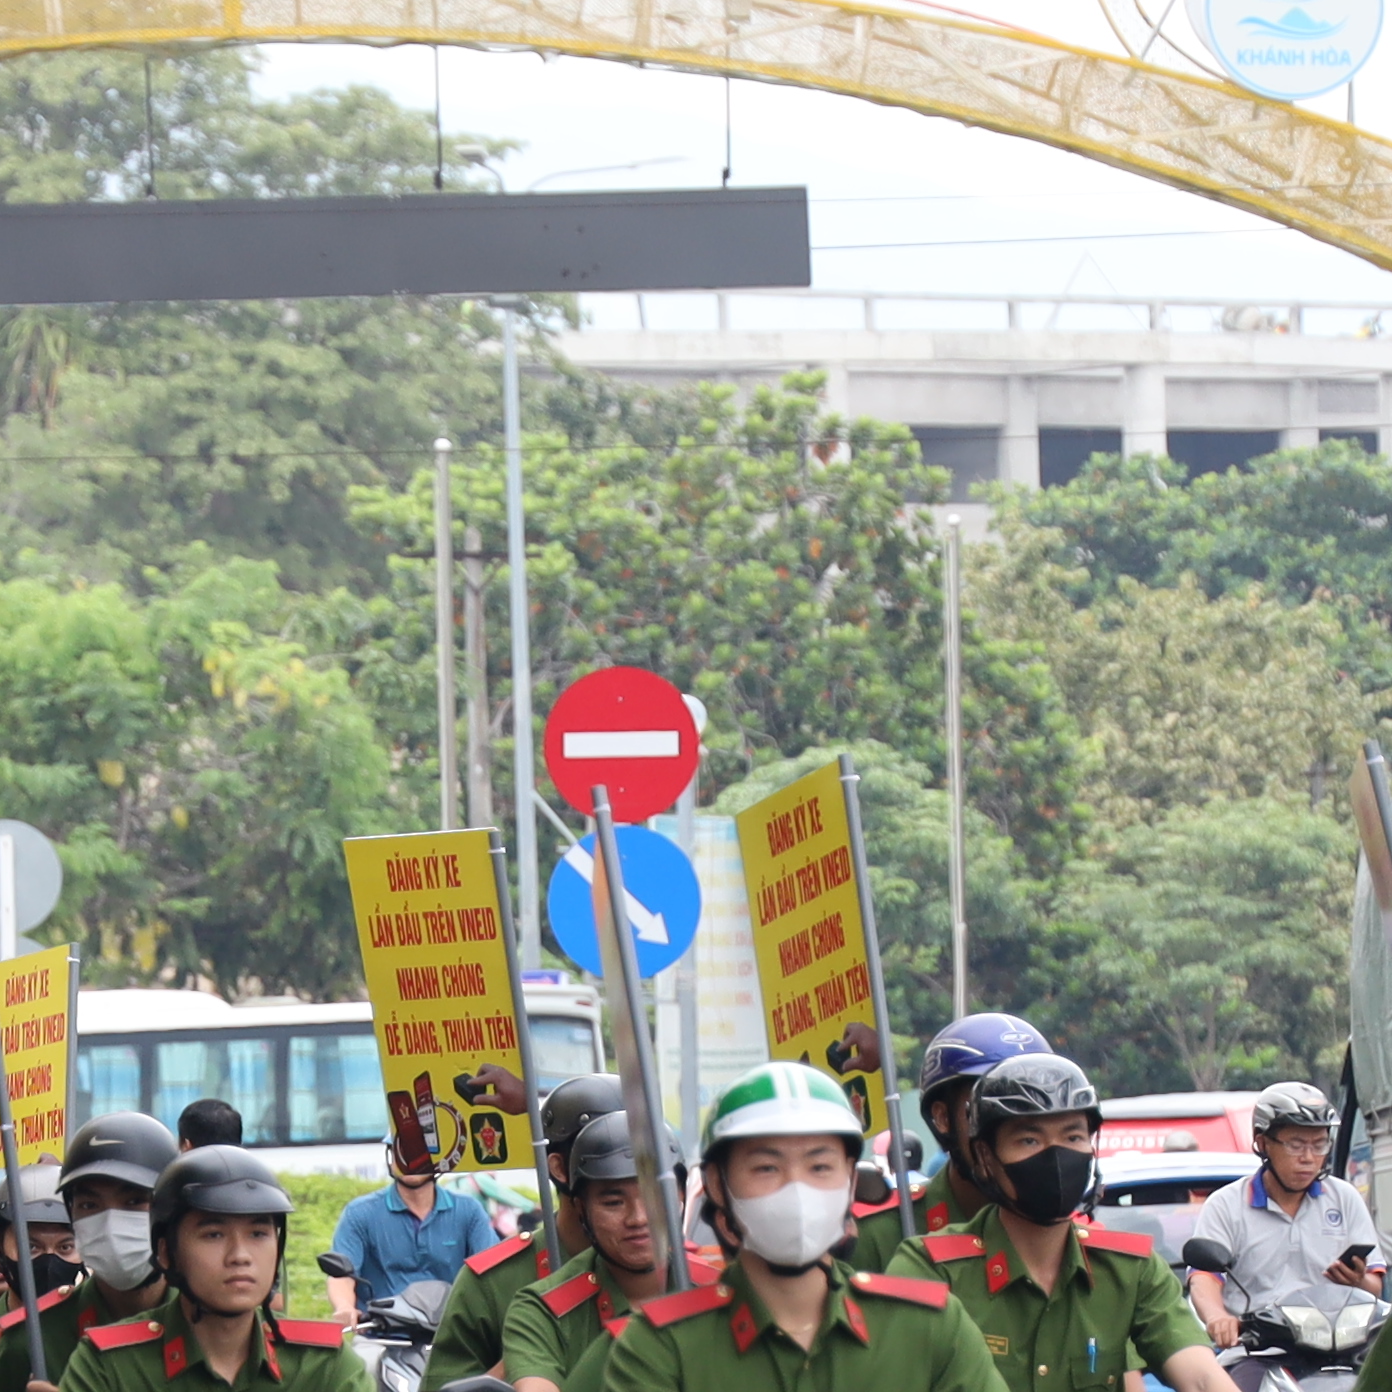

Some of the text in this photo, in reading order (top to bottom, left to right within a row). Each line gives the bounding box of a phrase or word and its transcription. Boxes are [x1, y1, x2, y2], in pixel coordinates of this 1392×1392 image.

[1236, 44, 1352, 66] KHÁNH HÒA
[766, 795, 824, 858] ĐĂNG KÝ XE
[386, 848, 462, 892] ĐĂNG KÝ XE
[757, 844, 851, 927] LẦN ĐẦU TRÊN VNEID
[368, 901, 497, 948] LẦN ĐẦU TRÊN VNEID
[778, 910, 845, 978] NHANH CHÓNG
[396, 956, 486, 1001] NHANH CHÓNG
[814, 969, 848, 1022] THUẬN
[845, 957, 870, 1011] TIỆN
[384, 1009, 516, 1059] DỄ DÀNG, THUẬN TIỆN
